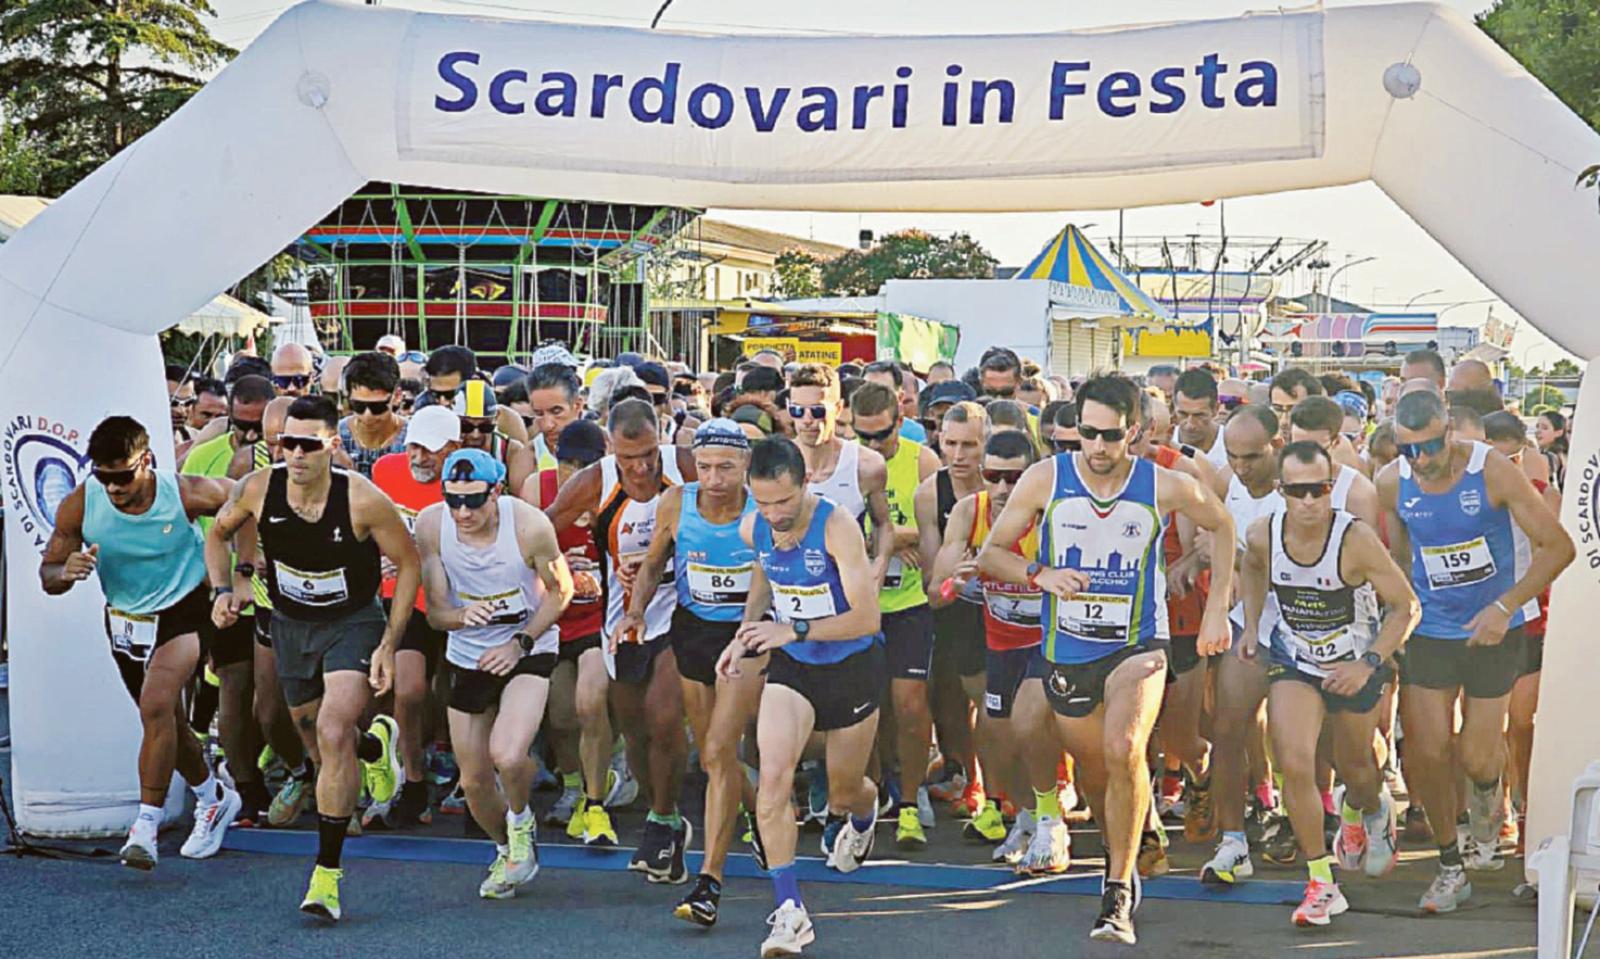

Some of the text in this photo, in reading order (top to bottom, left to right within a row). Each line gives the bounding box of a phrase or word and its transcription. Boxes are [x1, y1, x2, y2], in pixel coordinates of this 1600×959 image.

[434, 51, 1278, 132] Scardovari in Festa
[798, 351, 838, 360] ATATINE
[1578, 451, 1600, 544] SCARDOV
[1440, 552, 1471, 568] 159
[302, 579, 315, 591] 6
[711, 575, 735, 588] 86
[1090, 578, 1129, 586] ACCHIO
[791, 596, 803, 613] 2
[1010, 600, 1020, 610] 7
[1084, 604, 1103, 619] 12
[1308, 643, 1337, 658] 142
